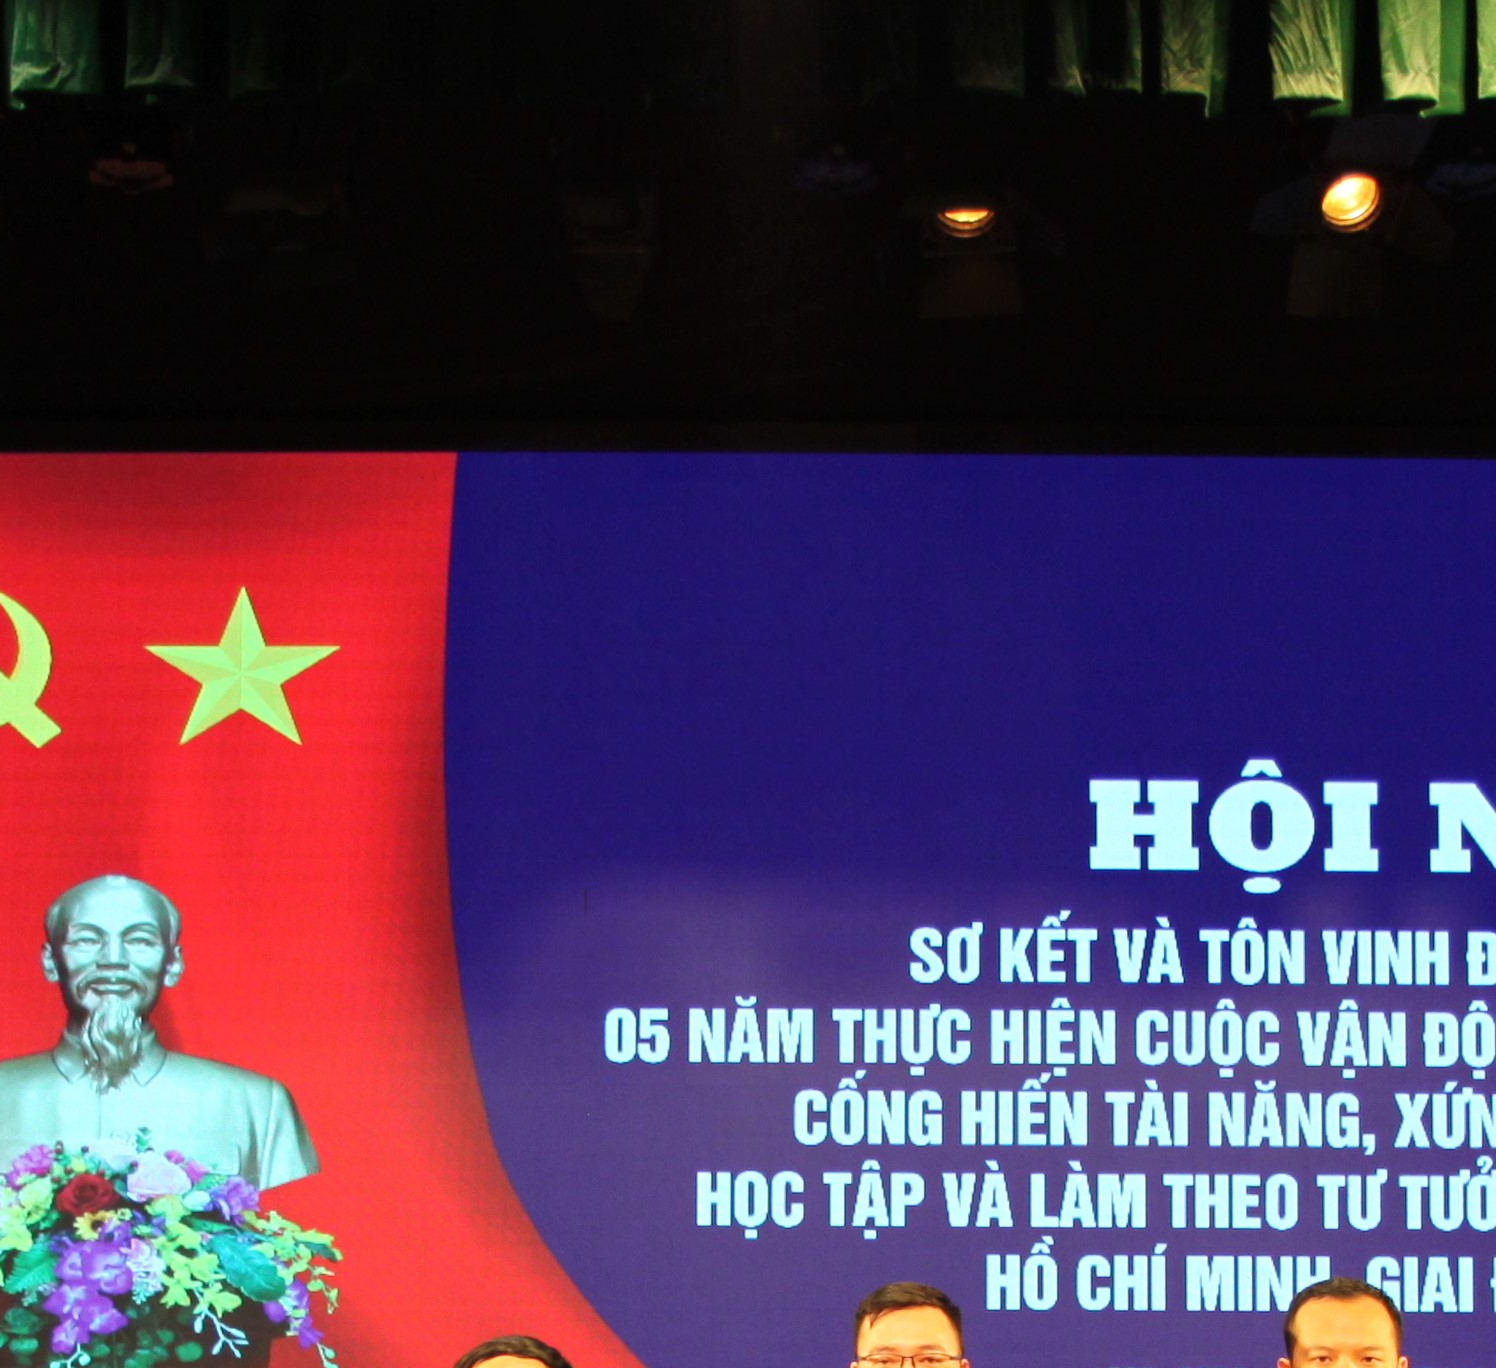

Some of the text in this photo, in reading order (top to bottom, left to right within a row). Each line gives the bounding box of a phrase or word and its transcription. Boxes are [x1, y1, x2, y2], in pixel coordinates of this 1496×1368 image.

[1088, 758, 1379, 894] HỘI
[909, 921, 984, 984] SƠ
[999, 909, 1098, 983] KẾT
[1112, 916, 1185, 984] VÀ
[1198, 916, 1306, 986] TÔN
[1321, 929, 1450, 986] VINH
[604, 1007, 671, 1064] 05
[688, 995, 814, 1064] NĂM
[831, 1002, 972, 1077] THỰC
[990, 996, 1117, 1078] HIỆN
[1135, 997, 1280, 1078] CUỘC
[1296, 998, 1407, 1079] VẬN
[793, 1068, 943, 1147] CỐNG
[960, 1070, 1088, 1148] HIẾN
[1104, 1078, 1189, 1148] TÀI
[1208, 1079, 1376, 1156] NĂNG,
[696, 1170, 805, 1240] HỌC
[822, 1158, 925, 1240] TẬP
[941, 1159, 1014, 1228] VÀ
[1029, 1159, 1147, 1229] LÀM
[1162, 1172, 1299, 1231] THEO
[1316, 1168, 1389, 1232] TƯ
[985, 1235, 1058, 1311] HỒ
[1076, 1242, 1168, 1312] CHÍ
[1365, 1255, 1474, 1313] GIAI
